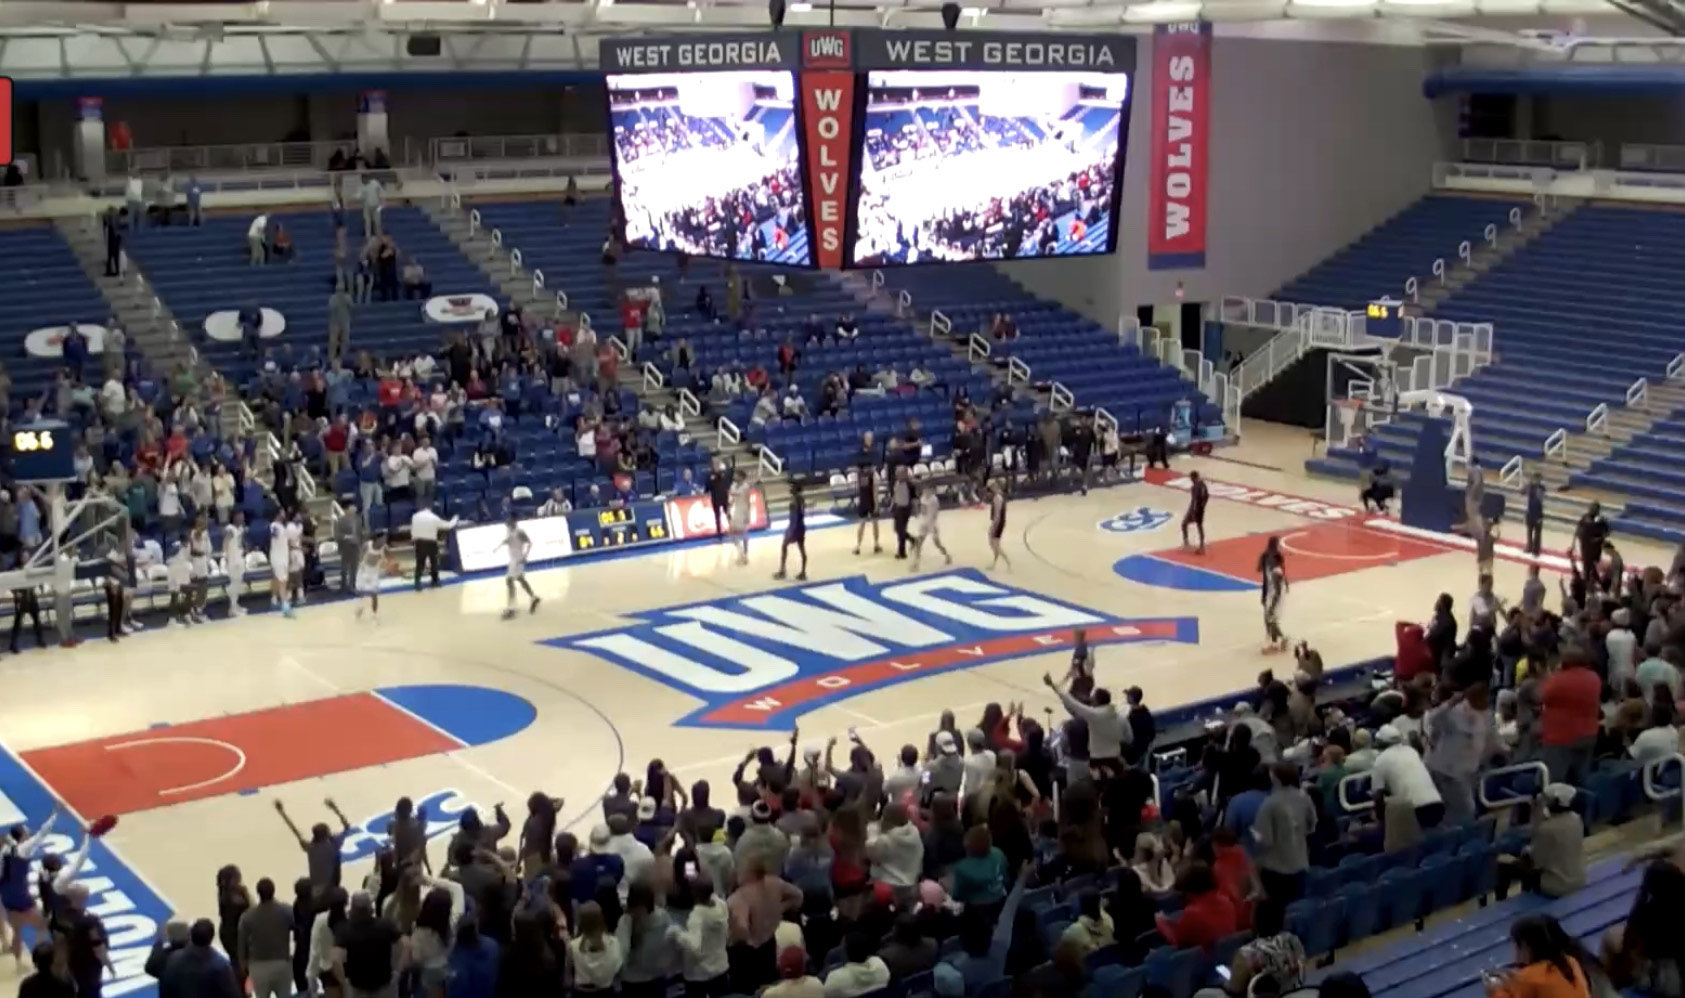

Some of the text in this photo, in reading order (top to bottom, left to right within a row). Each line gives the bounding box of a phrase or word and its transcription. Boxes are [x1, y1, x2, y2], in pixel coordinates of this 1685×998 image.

[616, 41, 782, 66] WEST GEORGIA
[811, 36, 844, 57] UWG
[886, 40, 1115, 66] WEST GEORGIA
[814, 88, 844, 251] WOLVES
[1165, 54, 1195, 240] WOLVES
[572, 575, 1106, 693] UWG
[743, 625, 1142, 712] WOLVES
